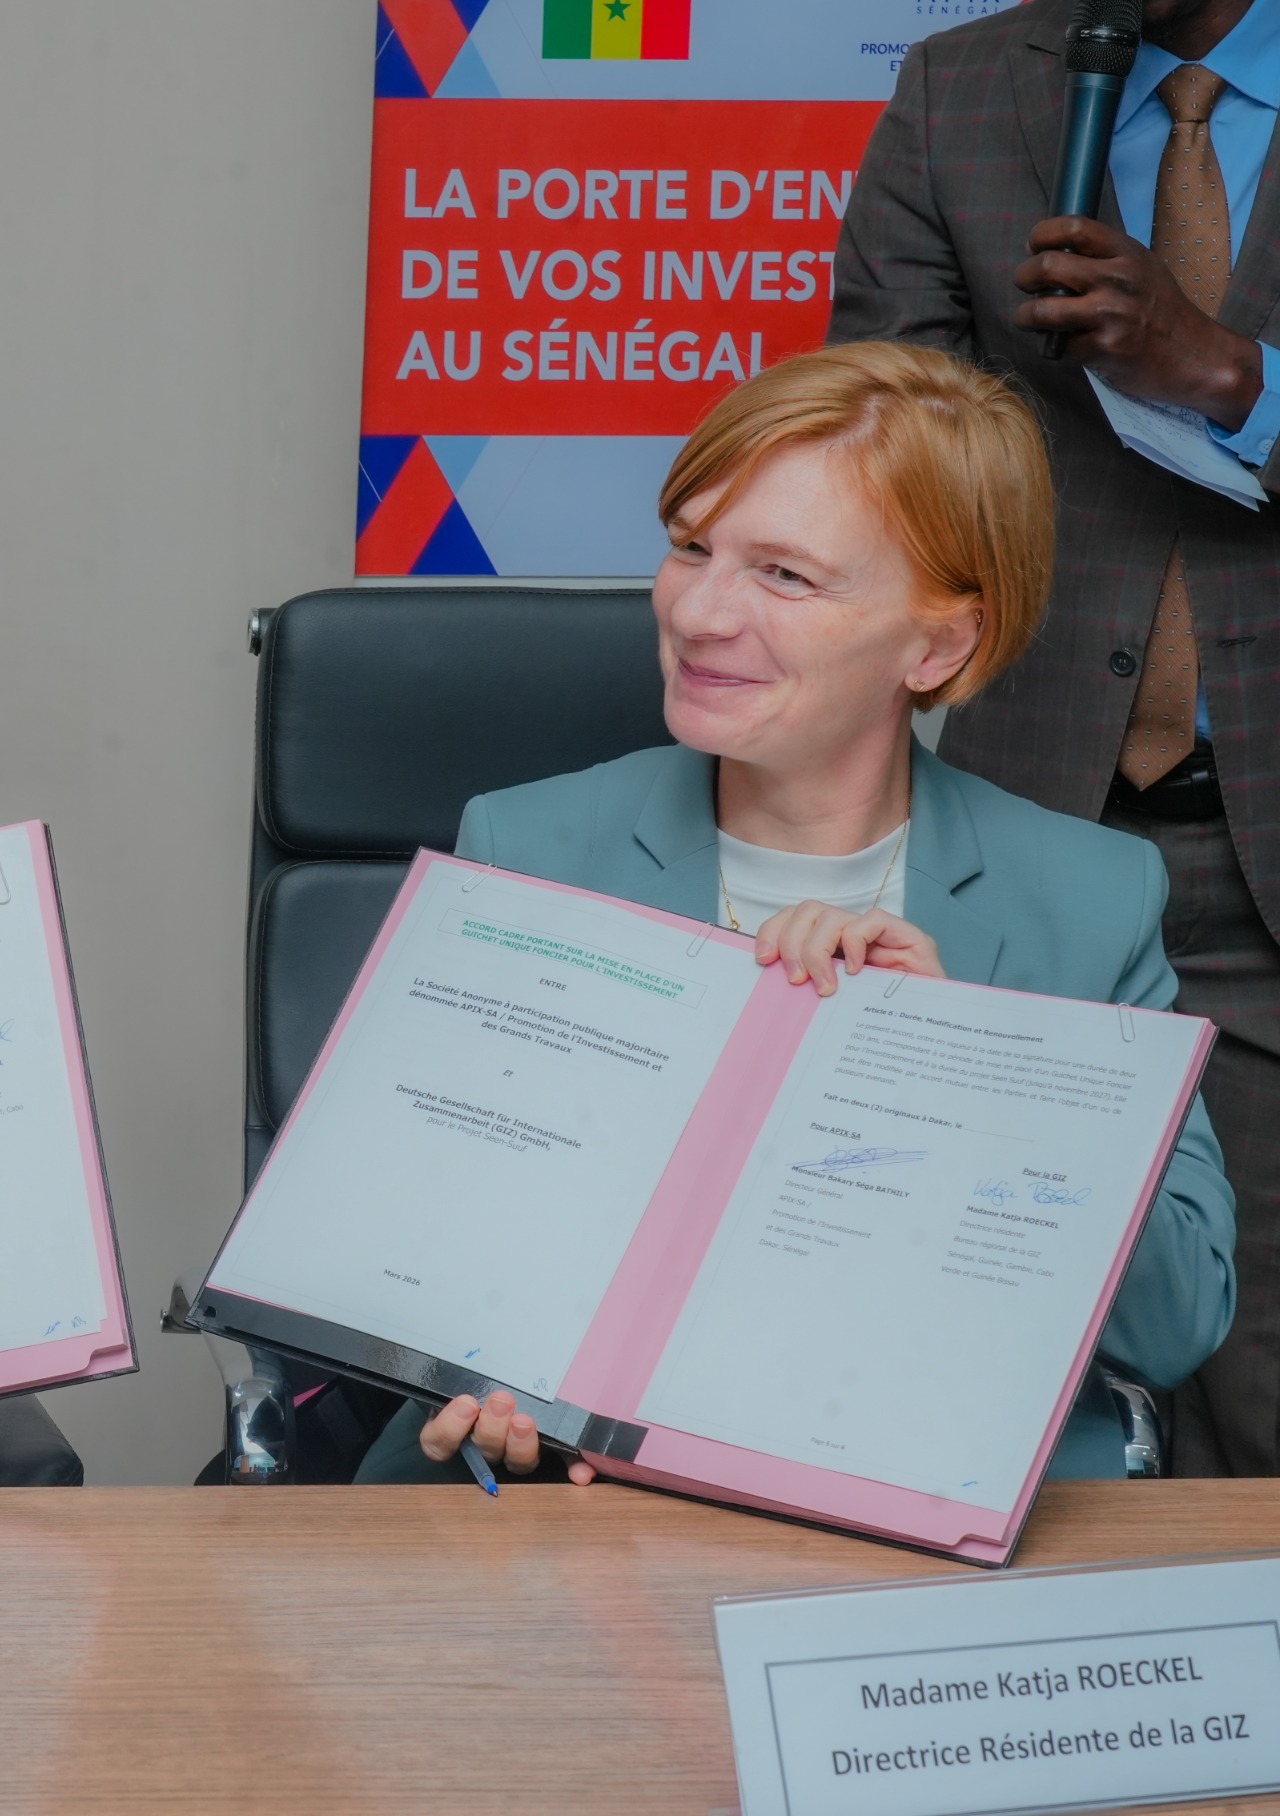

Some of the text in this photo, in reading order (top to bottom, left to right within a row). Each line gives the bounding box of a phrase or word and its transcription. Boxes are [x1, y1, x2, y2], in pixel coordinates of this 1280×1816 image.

[861, 43, 912, 55] PROMO
[404, 168, 859, 220] LA PORTE D'EN
[402, 249, 478, 299] DE
[499, 249, 622, 301] VOS
[395, 318, 766, 382] AU SÉNÉGAL
[461, 929, 679, 999] GUICHET UNIQUE FONCIER POUR L'INVESTISSEMENT
[463, 919, 684, 991] ACCORD CADRE PORTANT SUR LA MISE EN PLACE D'UN
[539, 978, 567, 991] ENTRE
[409, 989, 458, 1008] dénommée
[459, 1003, 497, 1017] APIX-SA
[507, 1014, 555, 1035] Promotion
[557, 1030, 569, 1039] de
[571, 1034, 650, 1067] l'Investissement
[651, 1064, 662, 1072] et
[413, 977, 424, 986] La
[425, 981, 459, 995] Société
[460, 990, 502, 1006] Anonyme
[510, 1004, 570, 1026] participation
[571, 1023, 614, 1041] publique
[615, 1038, 669, 1061] majoritaire
[481, 1020, 572, 1053] des Grands Travaux
[863, 1006, 887, 1015] Article
[898, 1012, 923, 1022] Durée,
[925, 1017, 972, 1032] Modification
[983, 1029, 1043, 1043] Renouvellement
[502, 1069, 514, 1077] Et
[395, 1084, 581, 1148] Deutsche Gesellschaft für Internationale
[412, 1099, 550, 1151] Zusammenarbeit (GIZ) GmbH,
[810, 1122, 861, 1141] Pour APIX-SA
[823, 1092, 838, 1101] Fait
[850, 1099, 869, 1108] deux
[870, 1104, 883, 1112] (2)
[884, 1108, 920, 1120] originaux
[928, 1116, 952, 1128] Dakar,
[827, 1174, 855, 1189] Bakary
[875, 1185, 910, 1198] BATHILY
[1022, 1168, 1040, 1179] Pour
[1049, 1172, 1067, 1183] GIZ
[966, 1205, 1058, 1229] Madame Katja ROECKEL
[383, 1269, 421, 1286] Mars 2026
[860, 1656, 1203, 1709] Madame Katja ROECKEL
[831, 1713, 1250, 1775] Directrice Résidente de la GIZ
